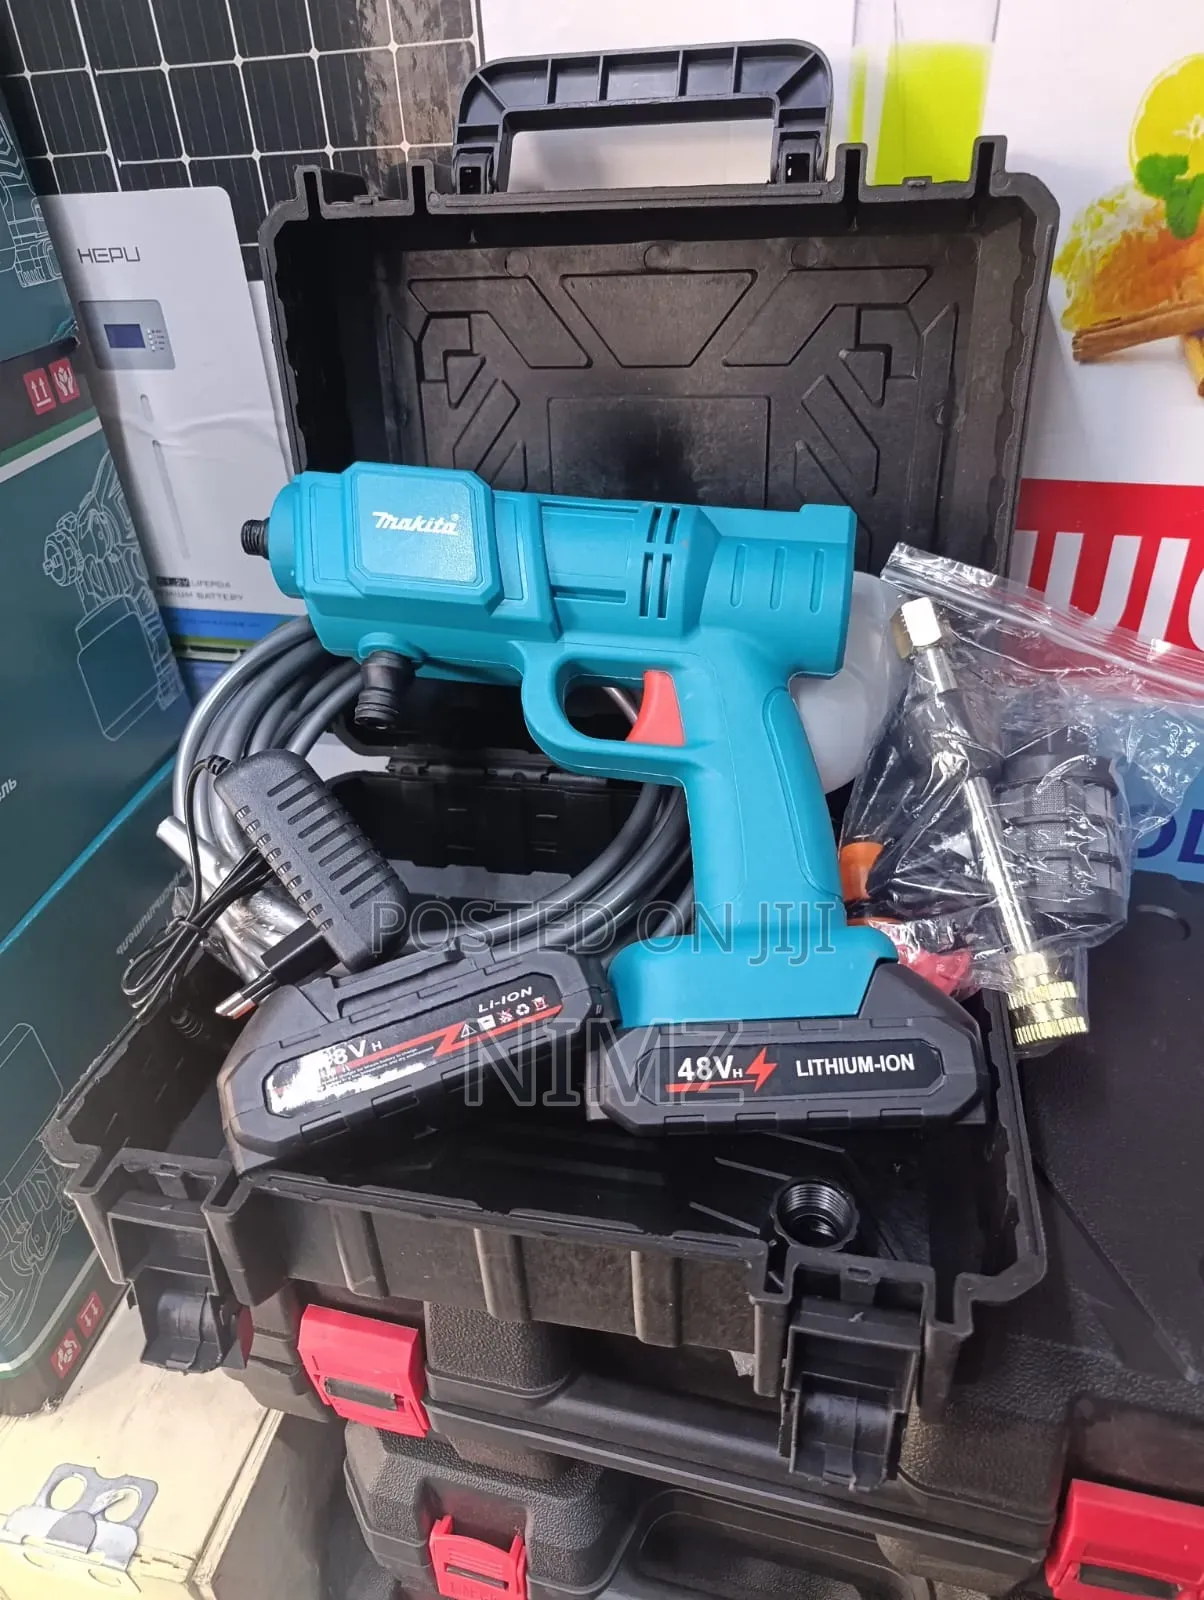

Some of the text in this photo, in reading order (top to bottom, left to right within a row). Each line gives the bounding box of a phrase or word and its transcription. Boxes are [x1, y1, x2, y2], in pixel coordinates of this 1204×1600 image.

[77, 246, 141, 264] HEPU
[478, 986, 534, 1013] LI-ION
[796, 1053, 915, 1077] LITHIUM-ION
